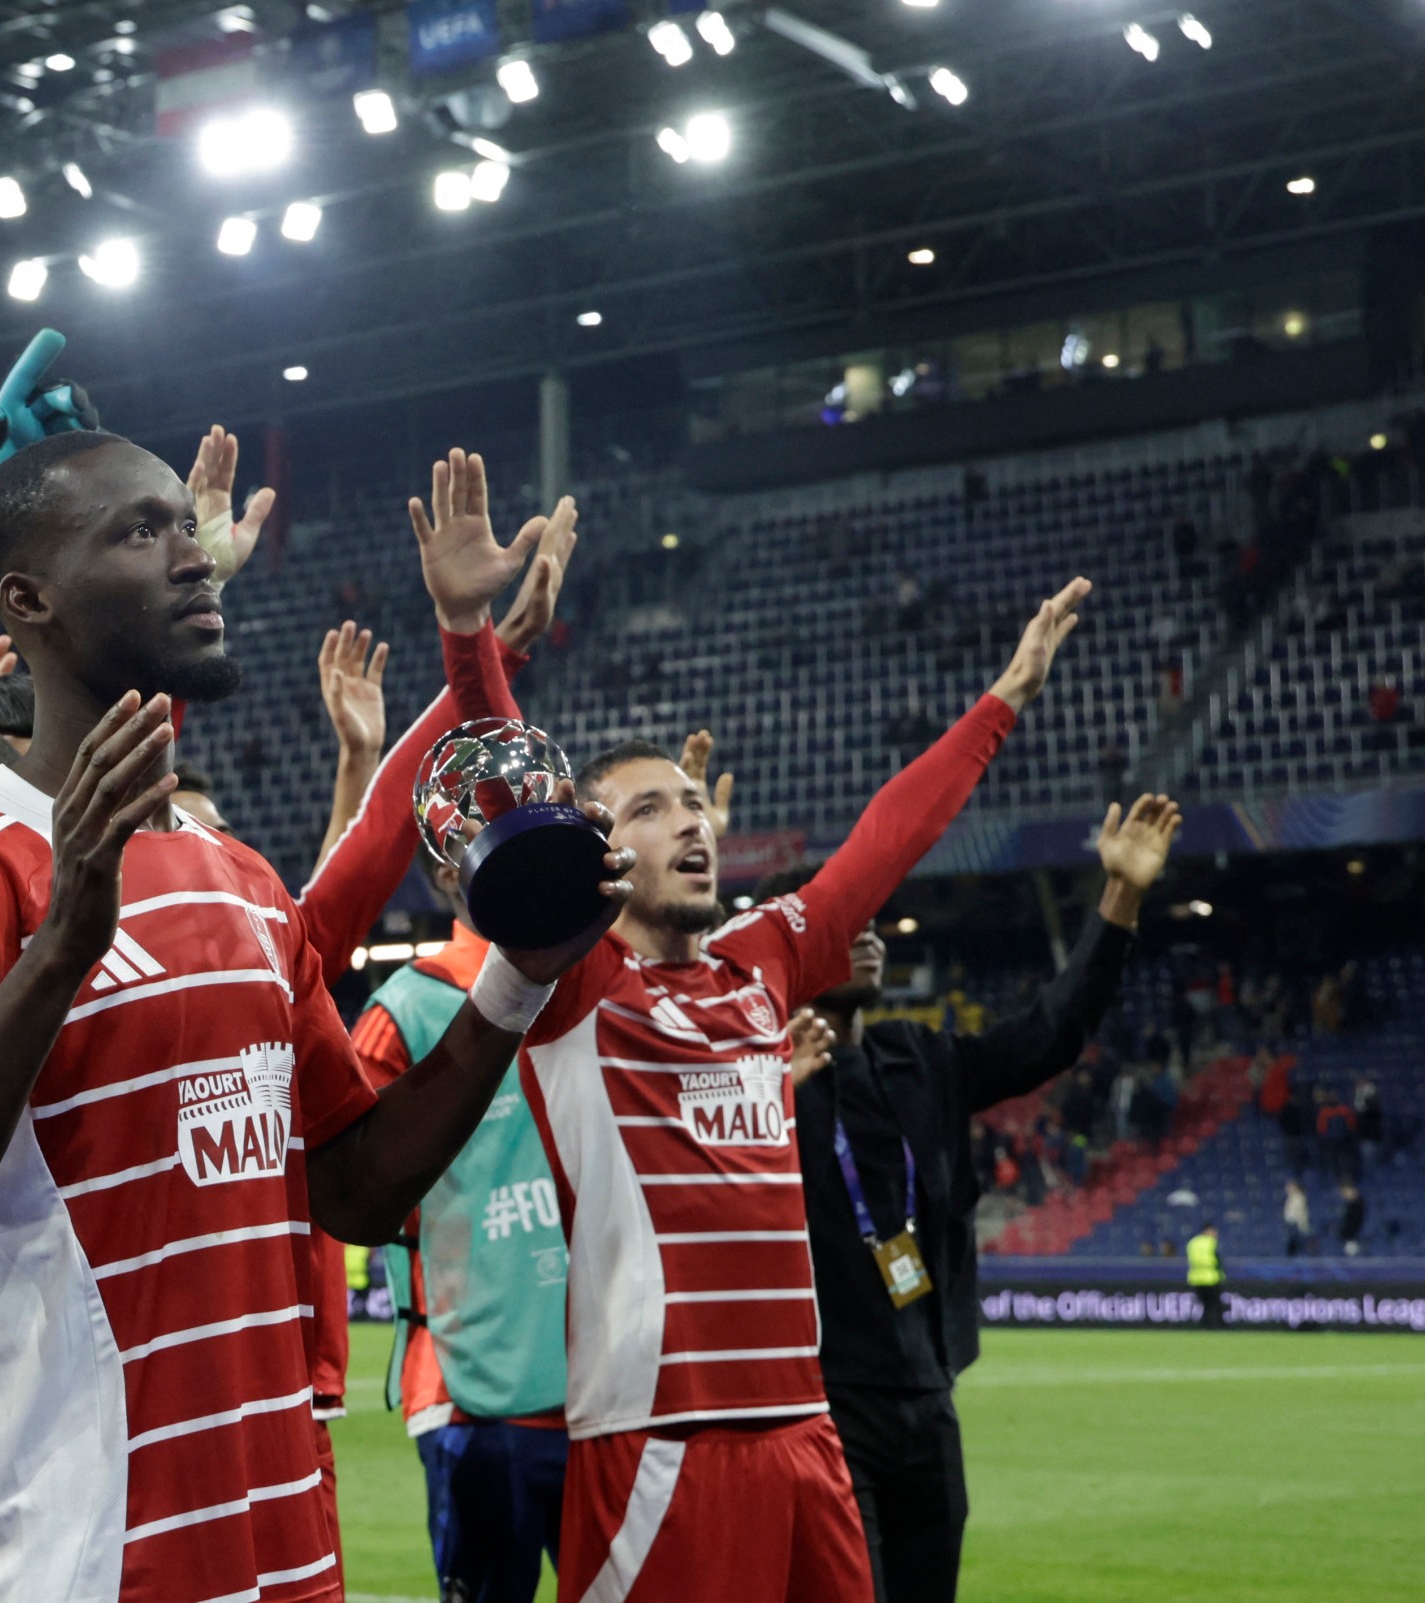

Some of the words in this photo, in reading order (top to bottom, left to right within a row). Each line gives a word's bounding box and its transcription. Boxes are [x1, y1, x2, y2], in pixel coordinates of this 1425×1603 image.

[418, 13, 484, 50] UEFA
[178, 1071, 243, 1105] YAOURT
[678, 1071, 740, 1091] YAOURT
[693, 1101, 781, 1141] MALO
[190, 1108, 285, 1180] MALO
[482, 1177, 561, 1241] #FO
[980, 1289, 1013, 1322] of
[1013, 1291, 1057, 1322] the
[1057, 1289, 1146, 1322] Official
